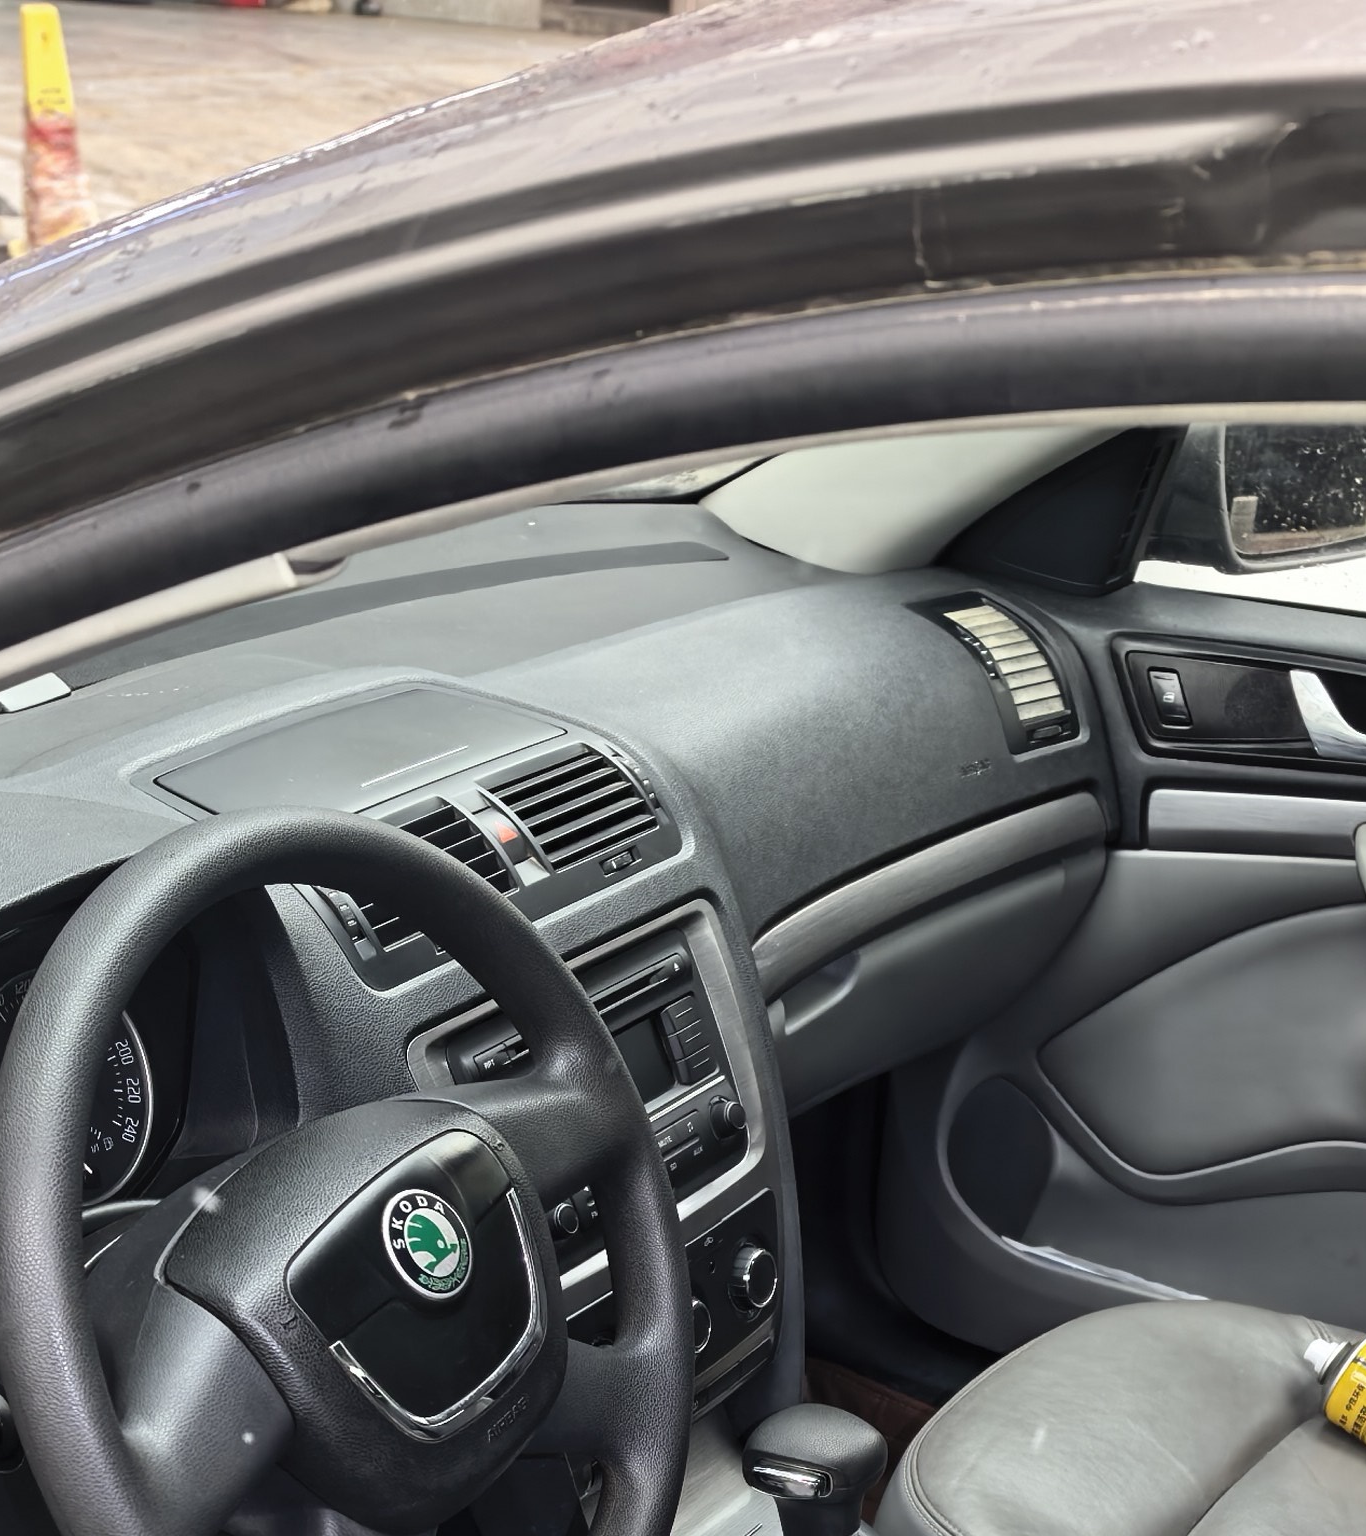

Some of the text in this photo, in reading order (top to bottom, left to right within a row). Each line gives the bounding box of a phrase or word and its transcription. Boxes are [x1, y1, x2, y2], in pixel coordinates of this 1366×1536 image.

[115, 1039, 135, 1066] 200
[126, 1078, 142, 1104] 220
[121, 1117, 140, 1143] 240
